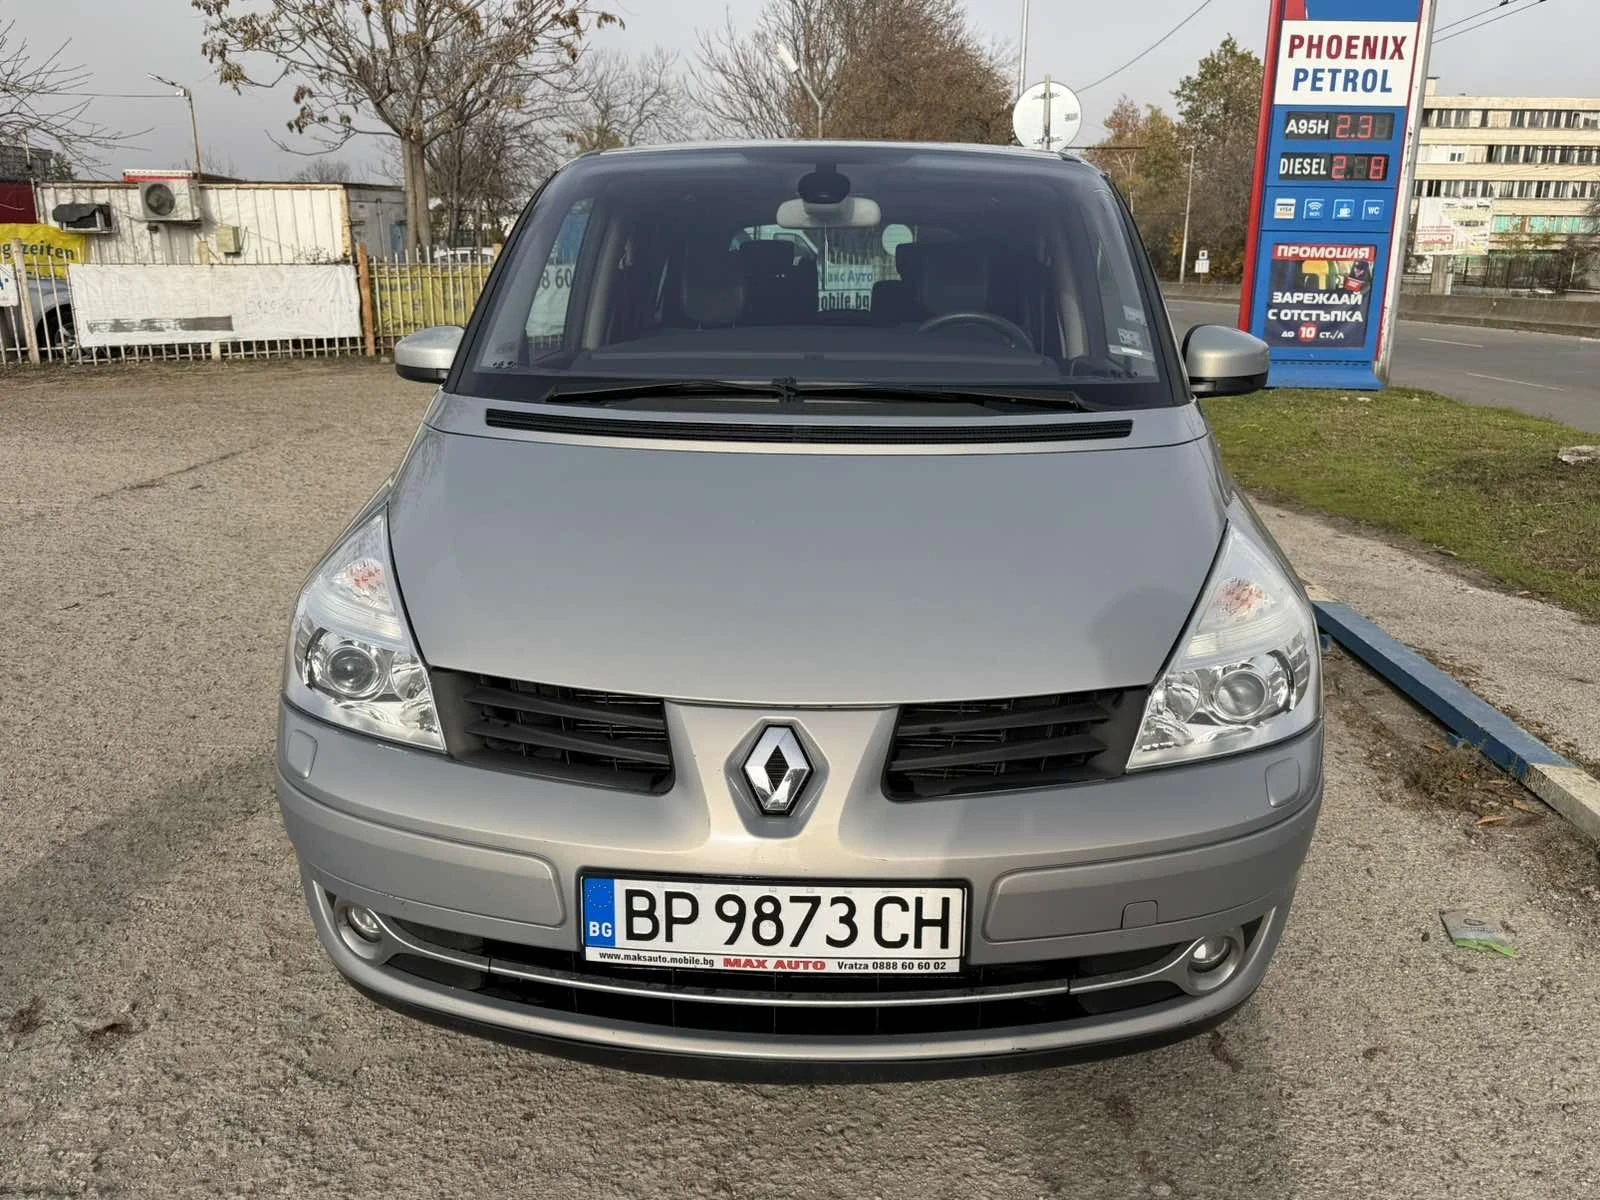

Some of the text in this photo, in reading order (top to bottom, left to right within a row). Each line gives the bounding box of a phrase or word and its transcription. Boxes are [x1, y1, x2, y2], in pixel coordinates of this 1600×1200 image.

[1288, 34, 1407, 60] PHOENIX
[1292, 68, 1392, 93] PETROL
[1285, 119, 1329, 134] A95H
[1279, 158, 1327, 174] DIESEL
[1368, 206, 1380, 215] WC
[3, 240, 74, 260] gzeiten
[1277, 245, 1370, 259] ПРОМОЦИЯ
[1272, 291, 1363, 305] ЗАРЕЖДАЙ
[1280, 309, 1364, 322] ОТСТЪПКА
[1300, 326, 1316, 338] 10
[625, 888, 951, 950] BP 9873 CH
[589, 921, 612, 937] BG
[599, 951, 947, 971] www.maksauto.mobile.bg MAX AUTO Vratza 0888 60 60 02
